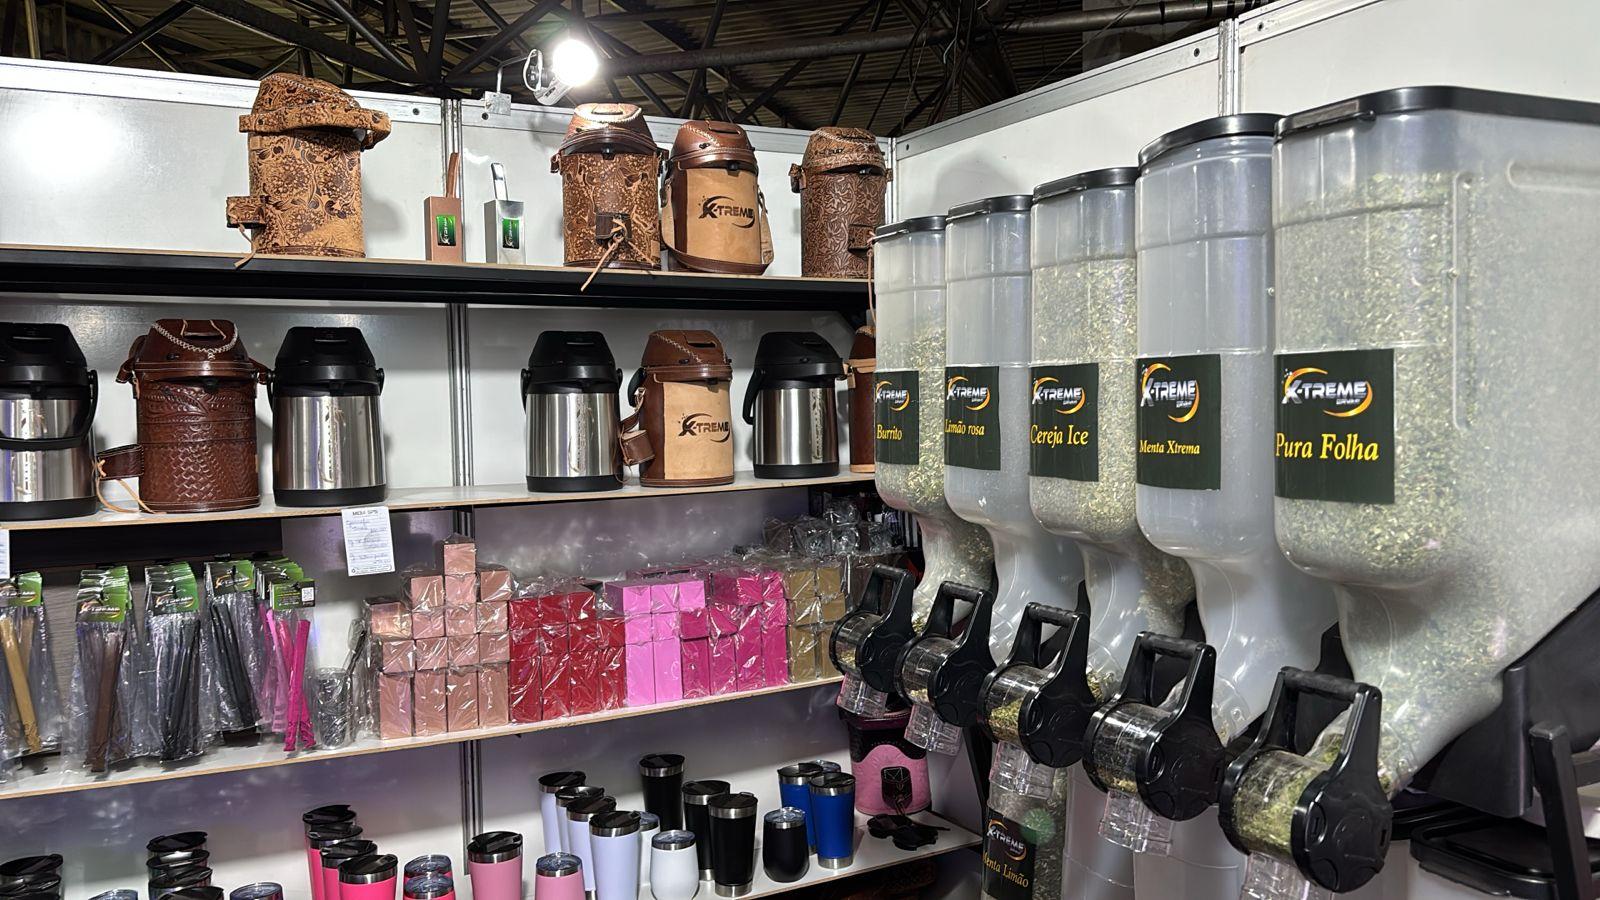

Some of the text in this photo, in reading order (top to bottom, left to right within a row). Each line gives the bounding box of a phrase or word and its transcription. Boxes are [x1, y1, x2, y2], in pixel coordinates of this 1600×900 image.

[698, 202, 754, 219] X-TREME
[875, 388, 908, 403] X-TREME
[946, 384, 988, 400] X-TREME
[1032, 386, 1083, 405] X-TREME
[1140, 378, 1196, 407] X-TREME
[1281, 380, 1367, 404] X-TREME
[678, 420, 730, 437] X-TREME
[876, 424, 903, 441] Burrito
[945, 419, 985, 436] Limão rosa
[1030, 424, 1089, 449] Cereja Ice
[1139, 439, 1200, 455] Menta Xtrema
[1275, 432, 1379, 461] Pura Folha
[986, 825, 1025, 850] X-TREME
[1002, 863, 1029, 888] Limão
